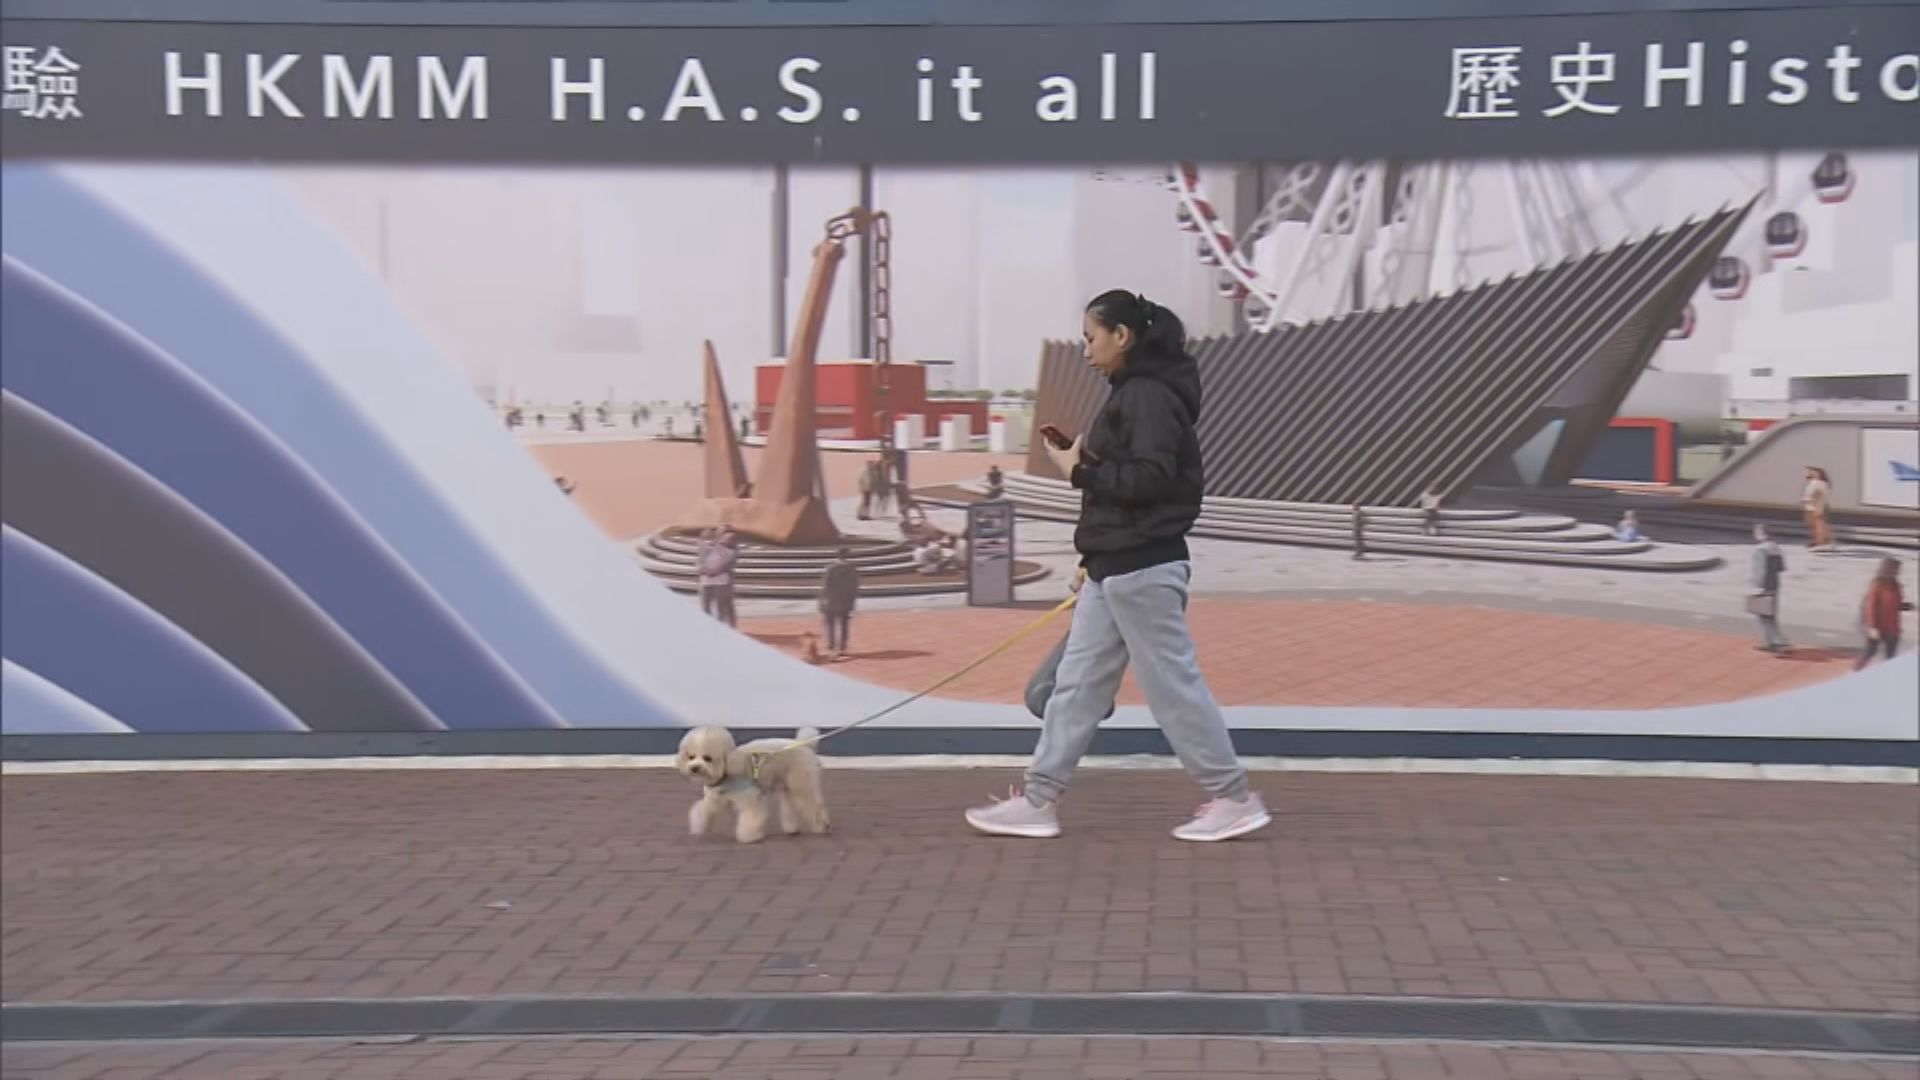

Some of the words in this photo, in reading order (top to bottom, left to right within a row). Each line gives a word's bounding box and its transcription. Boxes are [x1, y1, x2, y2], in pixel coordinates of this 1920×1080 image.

[164, 51, 489, 120] HKMM
[550, 57, 861, 123] H.A.S.
[916, 57, 983, 123] it
[1036, 52, 1157, 122] all
[1644, 39, 1919, 109] Histo
